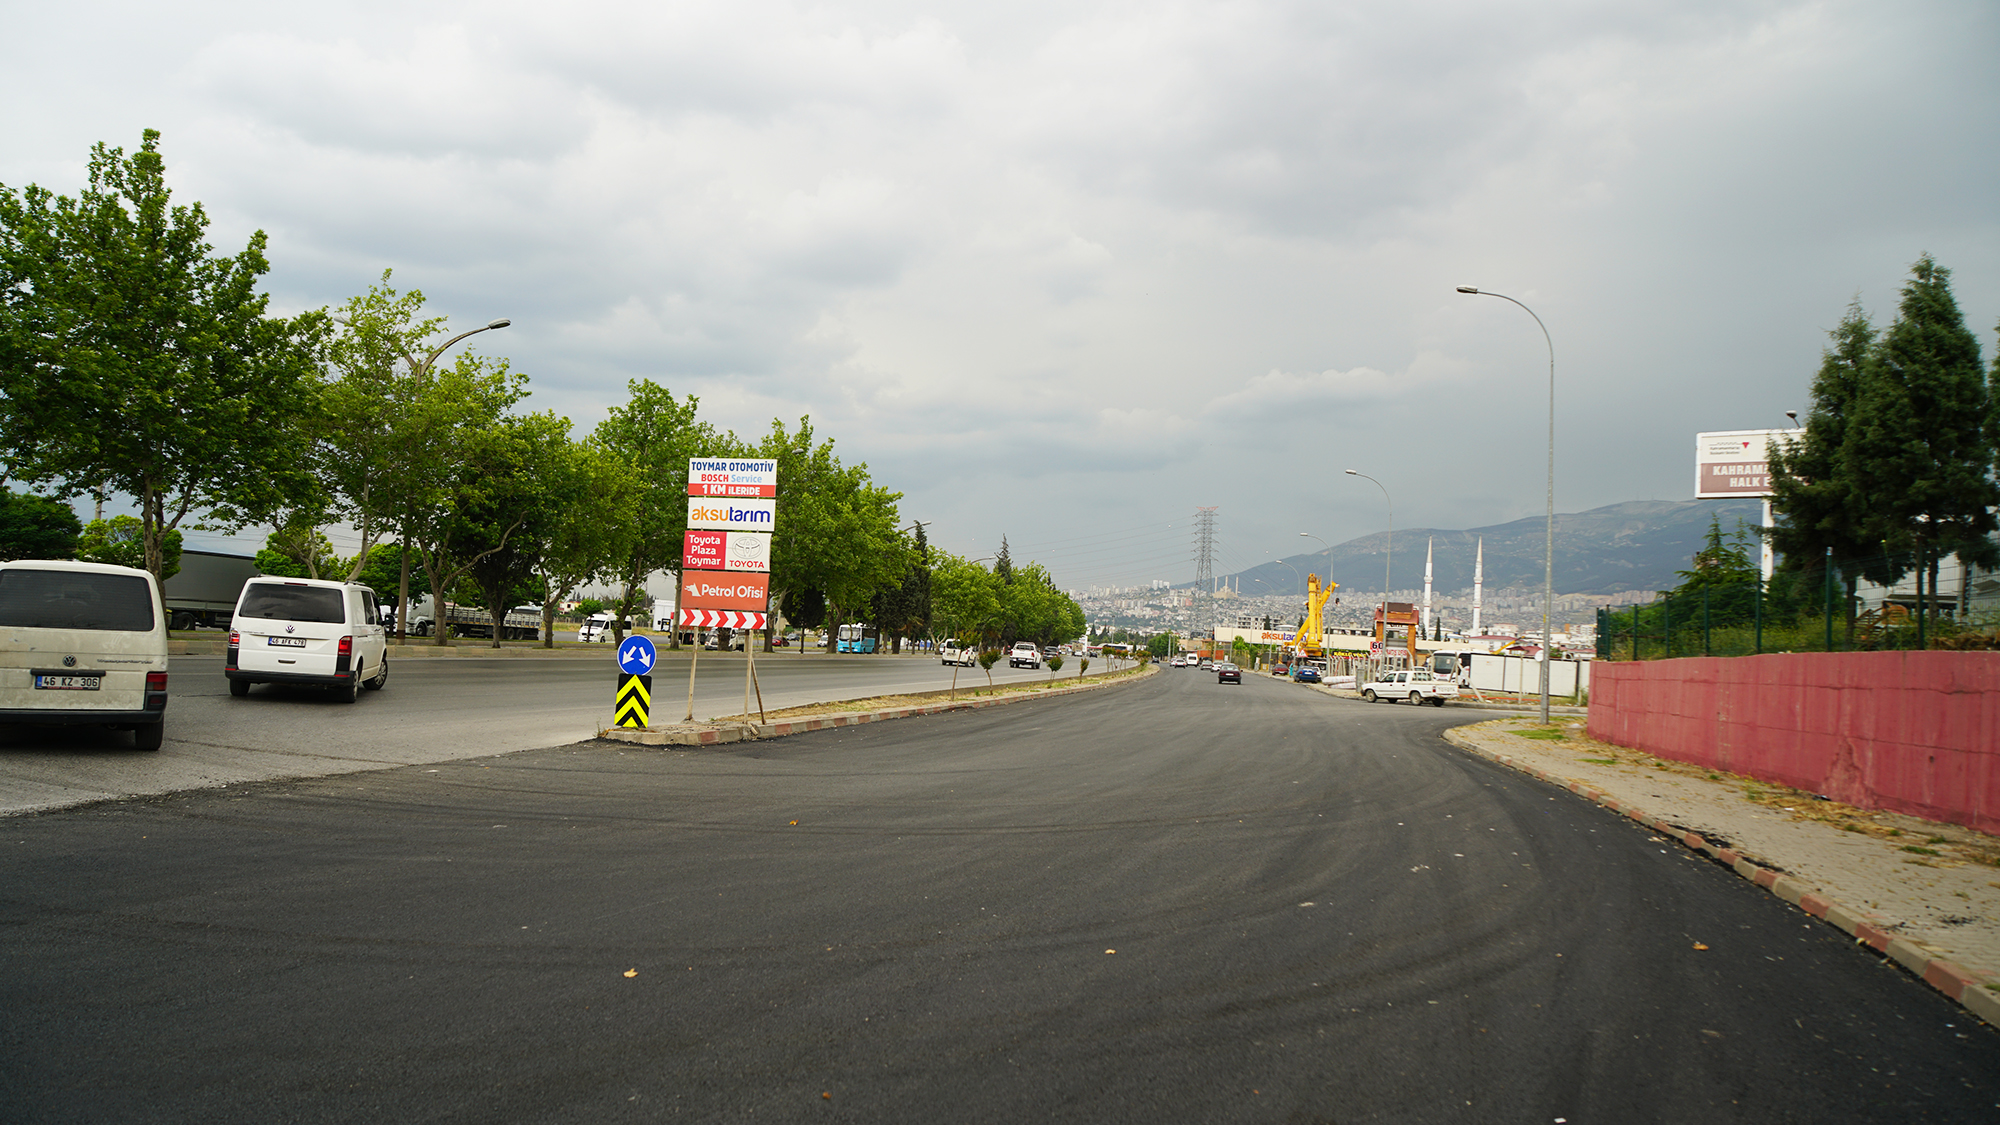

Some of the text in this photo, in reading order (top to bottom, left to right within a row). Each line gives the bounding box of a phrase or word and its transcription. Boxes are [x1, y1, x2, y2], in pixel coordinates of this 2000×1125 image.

[692, 461, 774, 472] TOYMAR OTOMOTİV
[701, 474, 762, 483] BOSCH Service
[1729, 477, 1760, 487] HALK
[702, 484, 708, 494] 1
[710, 484, 726, 494] KM
[691, 506, 771, 522] aksutarım
[689, 534, 721, 546] Toyota
[691, 545, 716, 555] Plaza
[686, 555, 721, 566] Toymar
[729, 560, 765, 569] TOYOTA
[702, 584, 763, 598] Petrol Ofisi
[44, 677, 98, 687] 46 KZ 306
